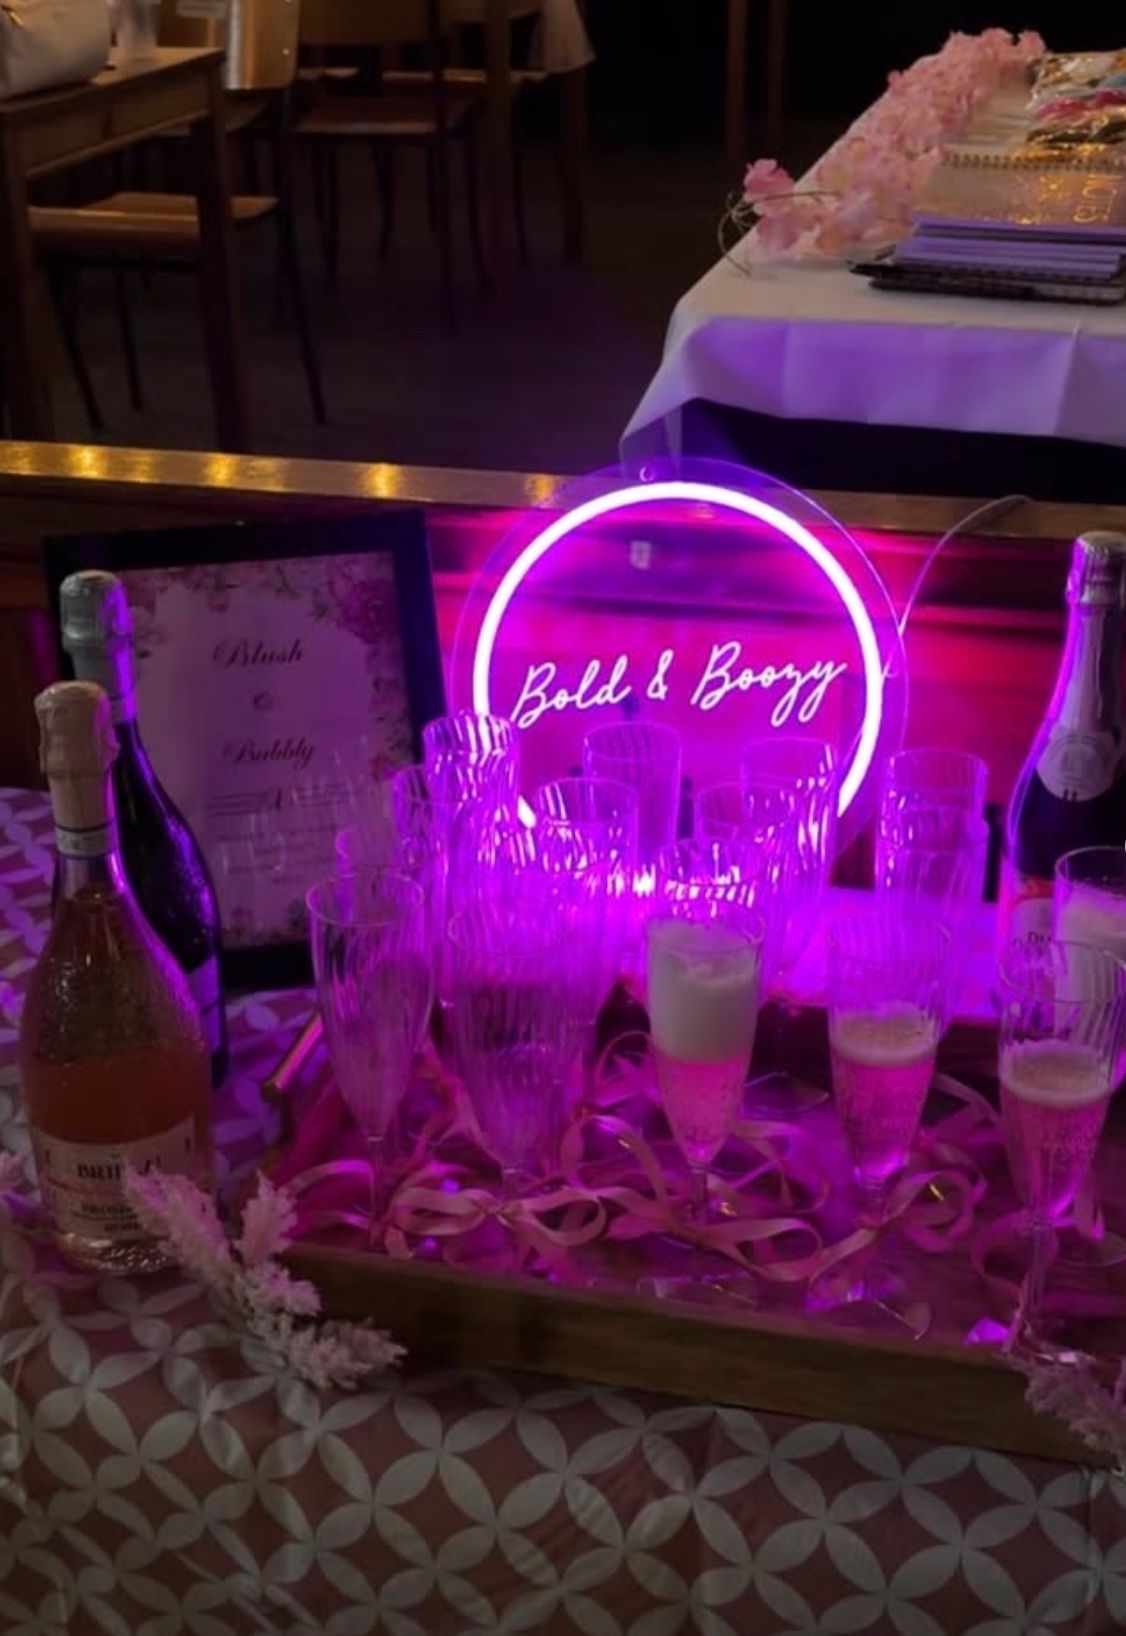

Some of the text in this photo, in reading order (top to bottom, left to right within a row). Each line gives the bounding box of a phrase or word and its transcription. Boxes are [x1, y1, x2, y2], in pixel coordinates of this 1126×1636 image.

[212, 638, 302, 668] Blush
[510, 641, 847, 729] Bold & Boozy
